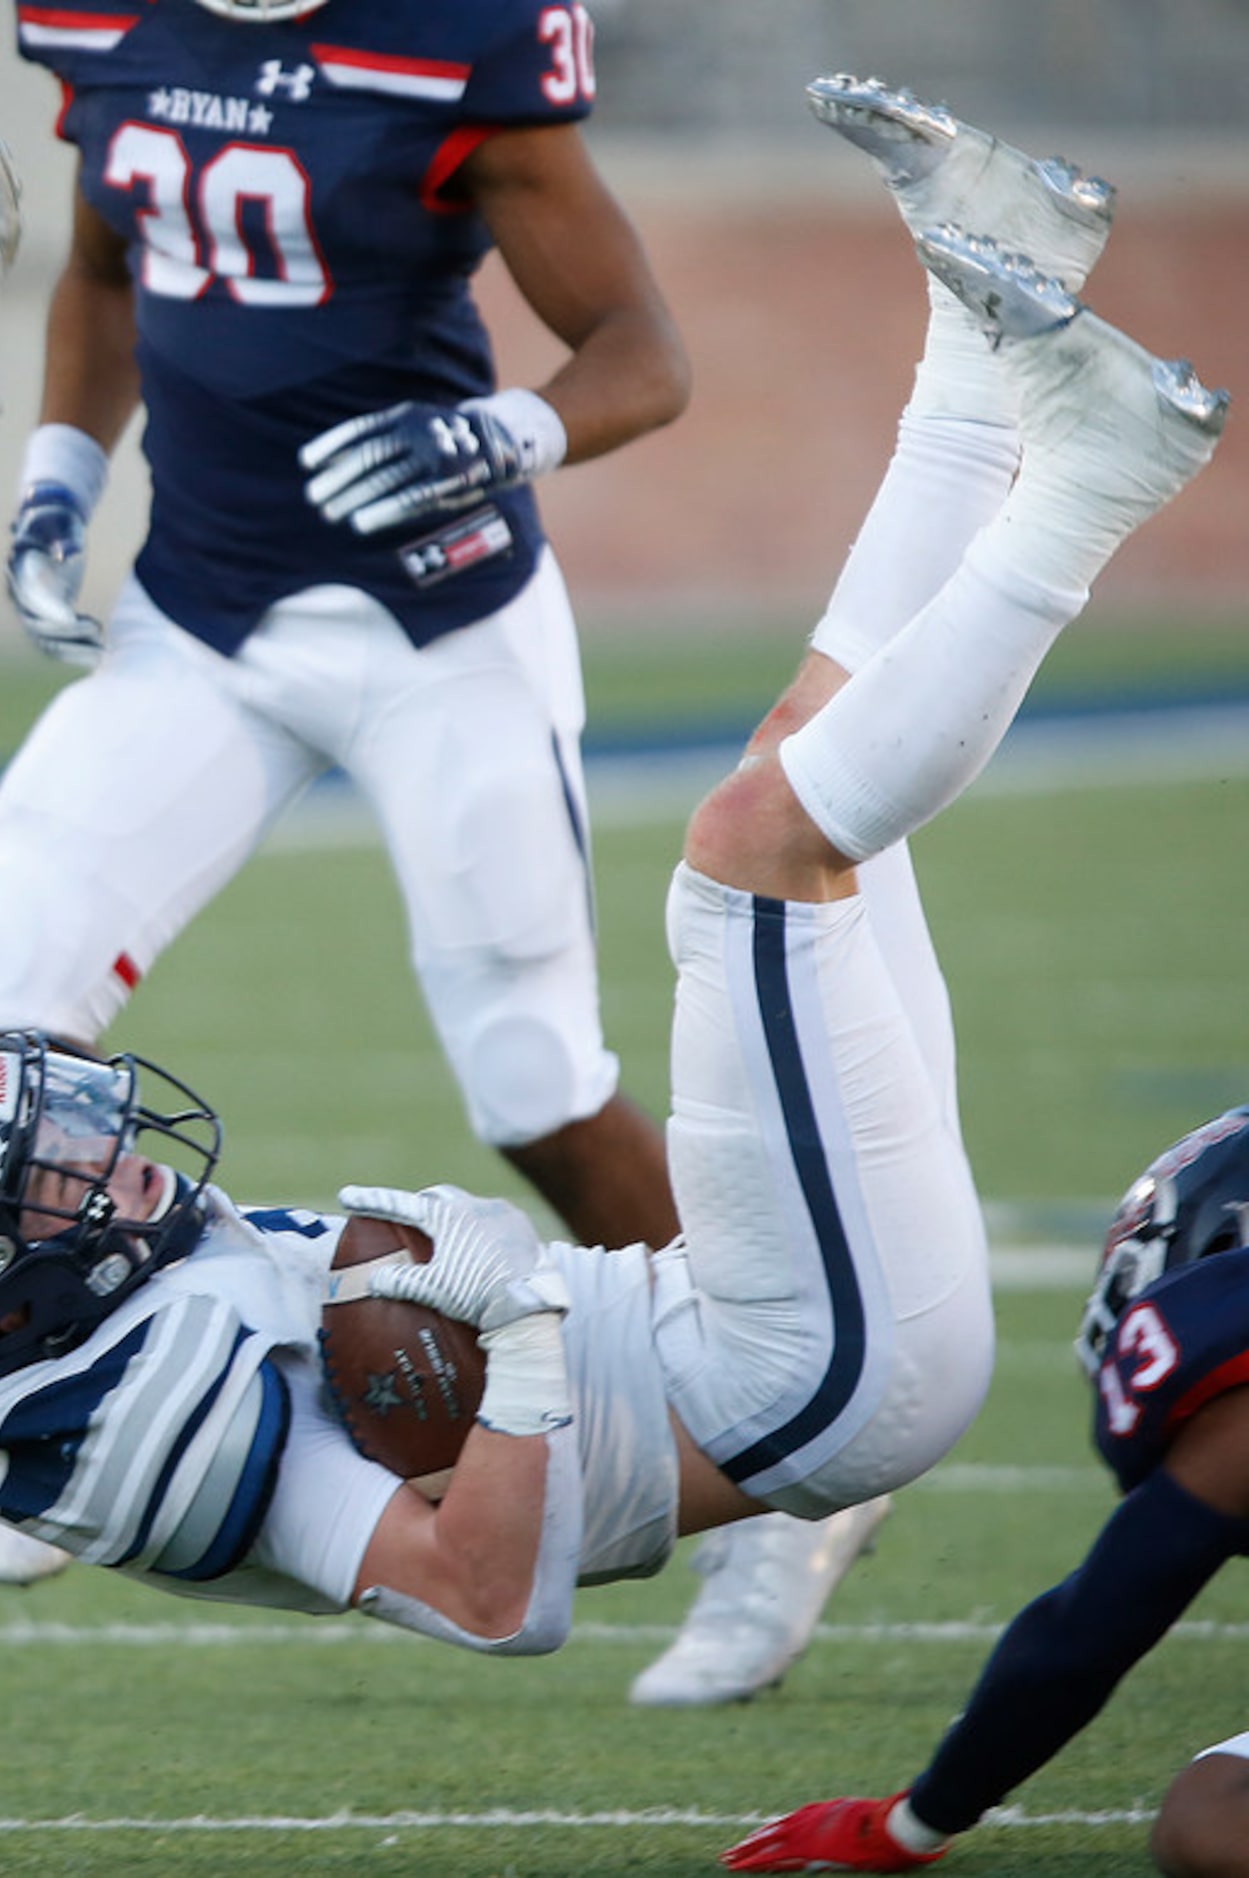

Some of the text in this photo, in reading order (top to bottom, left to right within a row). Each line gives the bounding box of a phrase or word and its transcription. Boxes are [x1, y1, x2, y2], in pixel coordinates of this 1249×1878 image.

[170, 85, 250, 133] RYAN
[537, 2, 596, 106] 30
[103, 119, 335, 306] 30
[1097, 1300, 1181, 1436] 13
